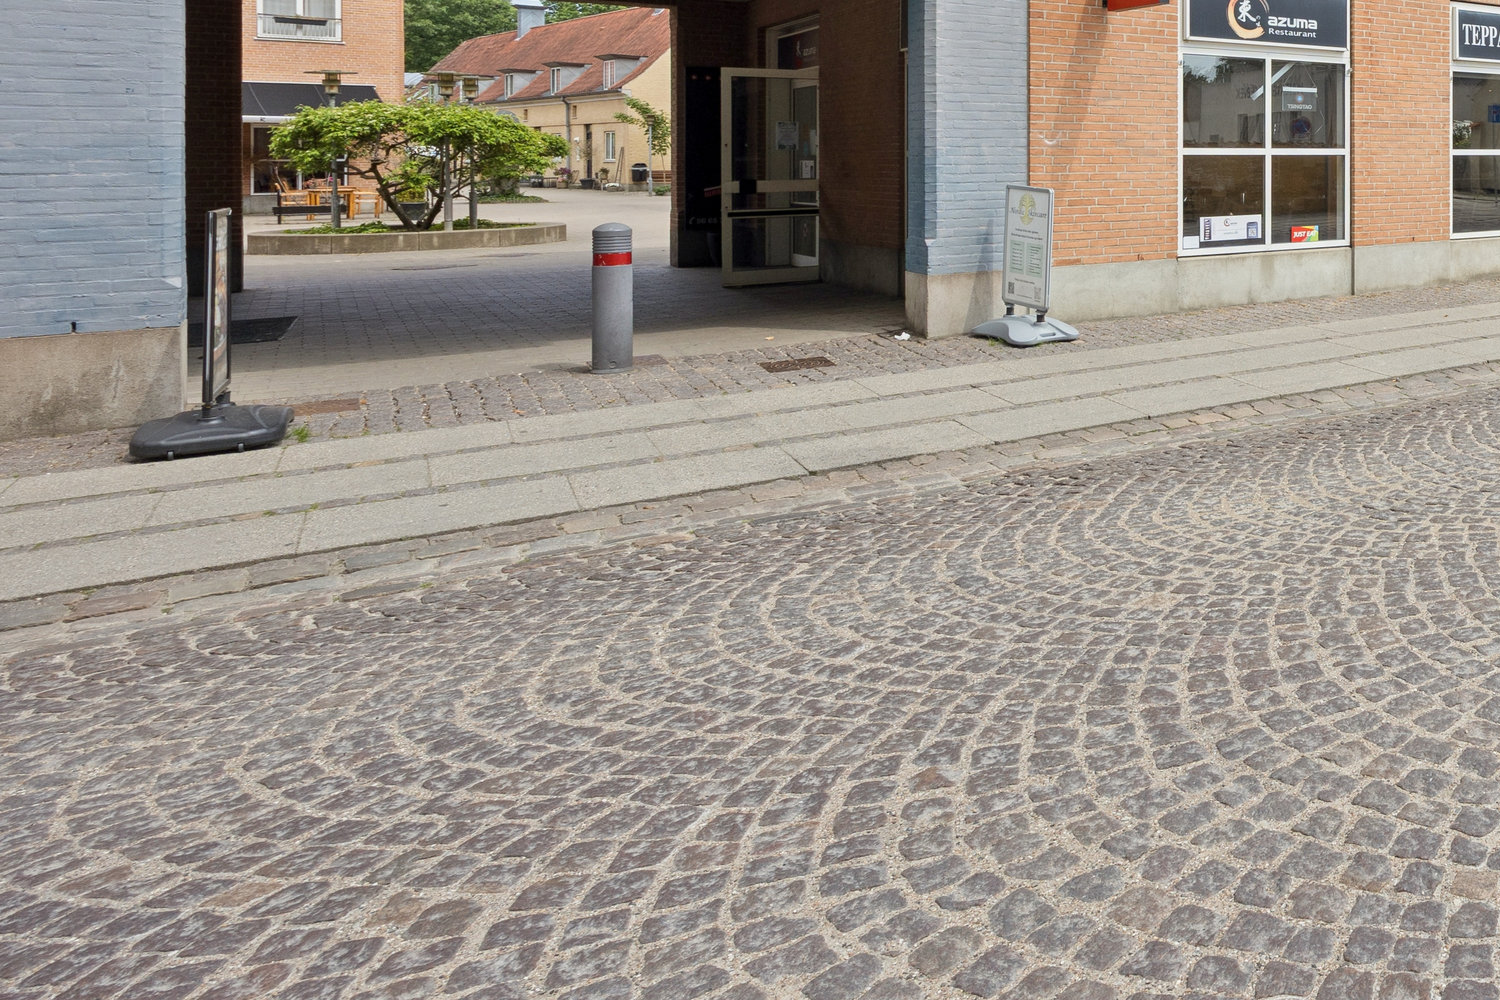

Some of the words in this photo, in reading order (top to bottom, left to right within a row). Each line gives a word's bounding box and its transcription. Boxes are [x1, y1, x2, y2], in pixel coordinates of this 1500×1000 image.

[1267, 15, 1318, 30] azuma
[1268, 28, 1317, 39] Restaurant
[1293, 231, 1306, 239] JUST
